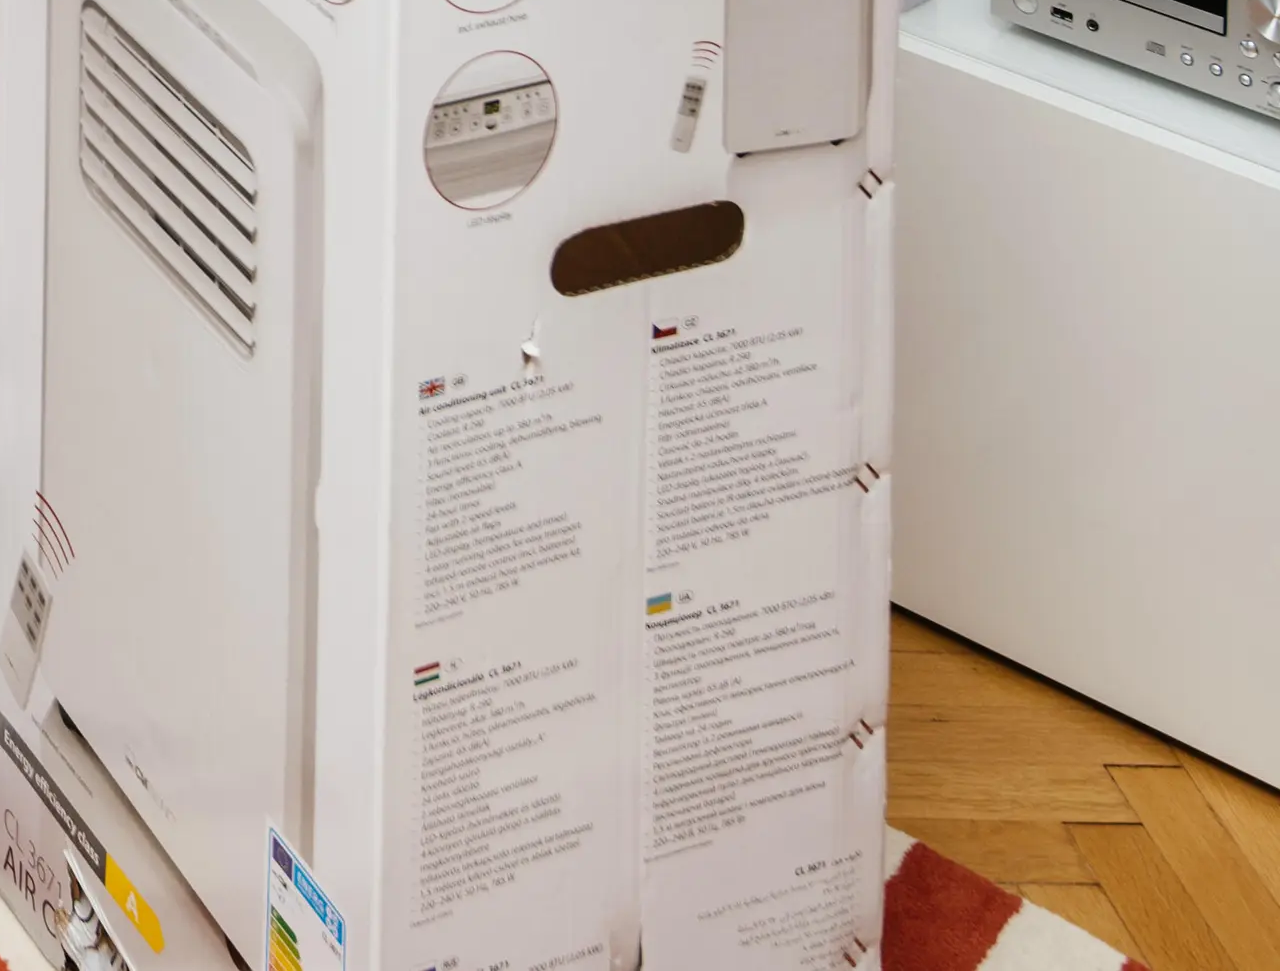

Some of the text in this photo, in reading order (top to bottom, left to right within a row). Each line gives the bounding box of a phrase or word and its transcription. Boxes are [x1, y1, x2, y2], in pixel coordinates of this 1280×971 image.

[419, 406, 429, 415] Air
[433, 392, 486, 413] conditioning
[3, 728, 34, 778] Energy
[35, 770, 77, 837] efficiency
[77, 830, 101, 867] class
[126, 890, 139, 924] A
[3, 808, 63, 899] CL 3671
[3, 845, 37, 912] AIR
